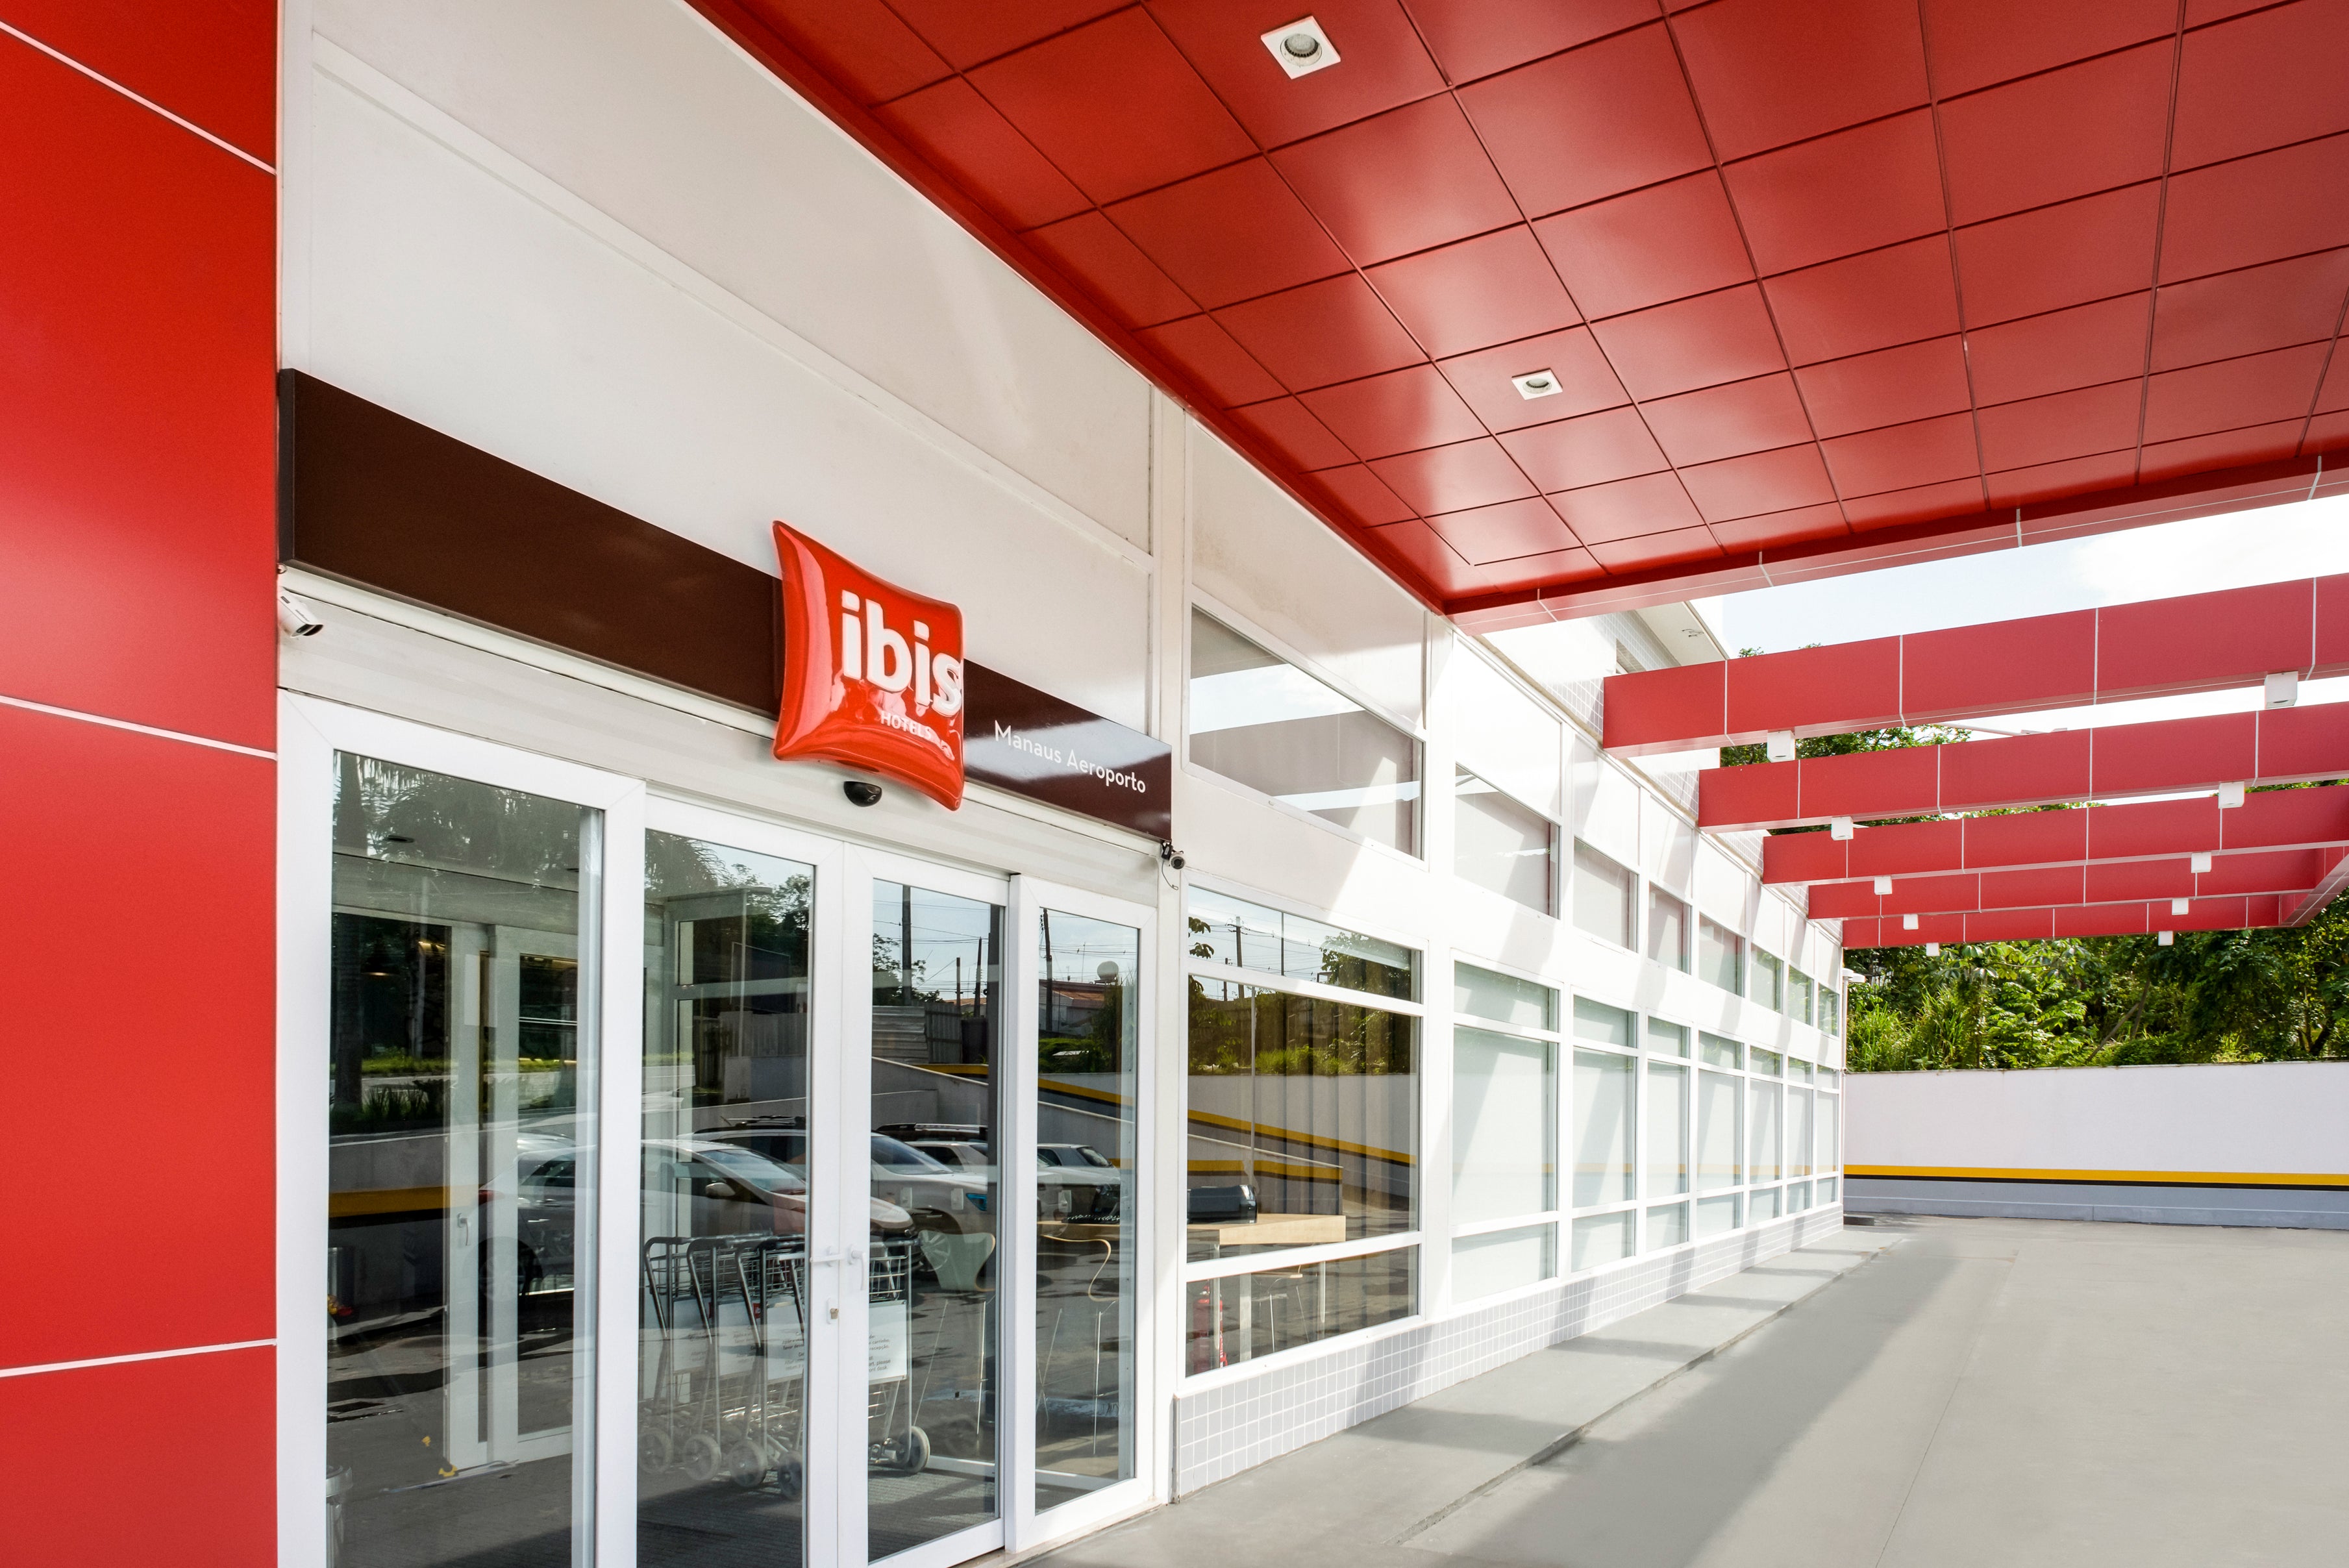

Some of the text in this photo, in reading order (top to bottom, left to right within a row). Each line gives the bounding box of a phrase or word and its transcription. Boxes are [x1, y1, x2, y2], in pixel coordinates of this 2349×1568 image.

[842, 590, 962, 717] ibis
[881, 710, 931, 740] HOTELS
[995, 720, 1146, 793] Manaus Aeroporto
